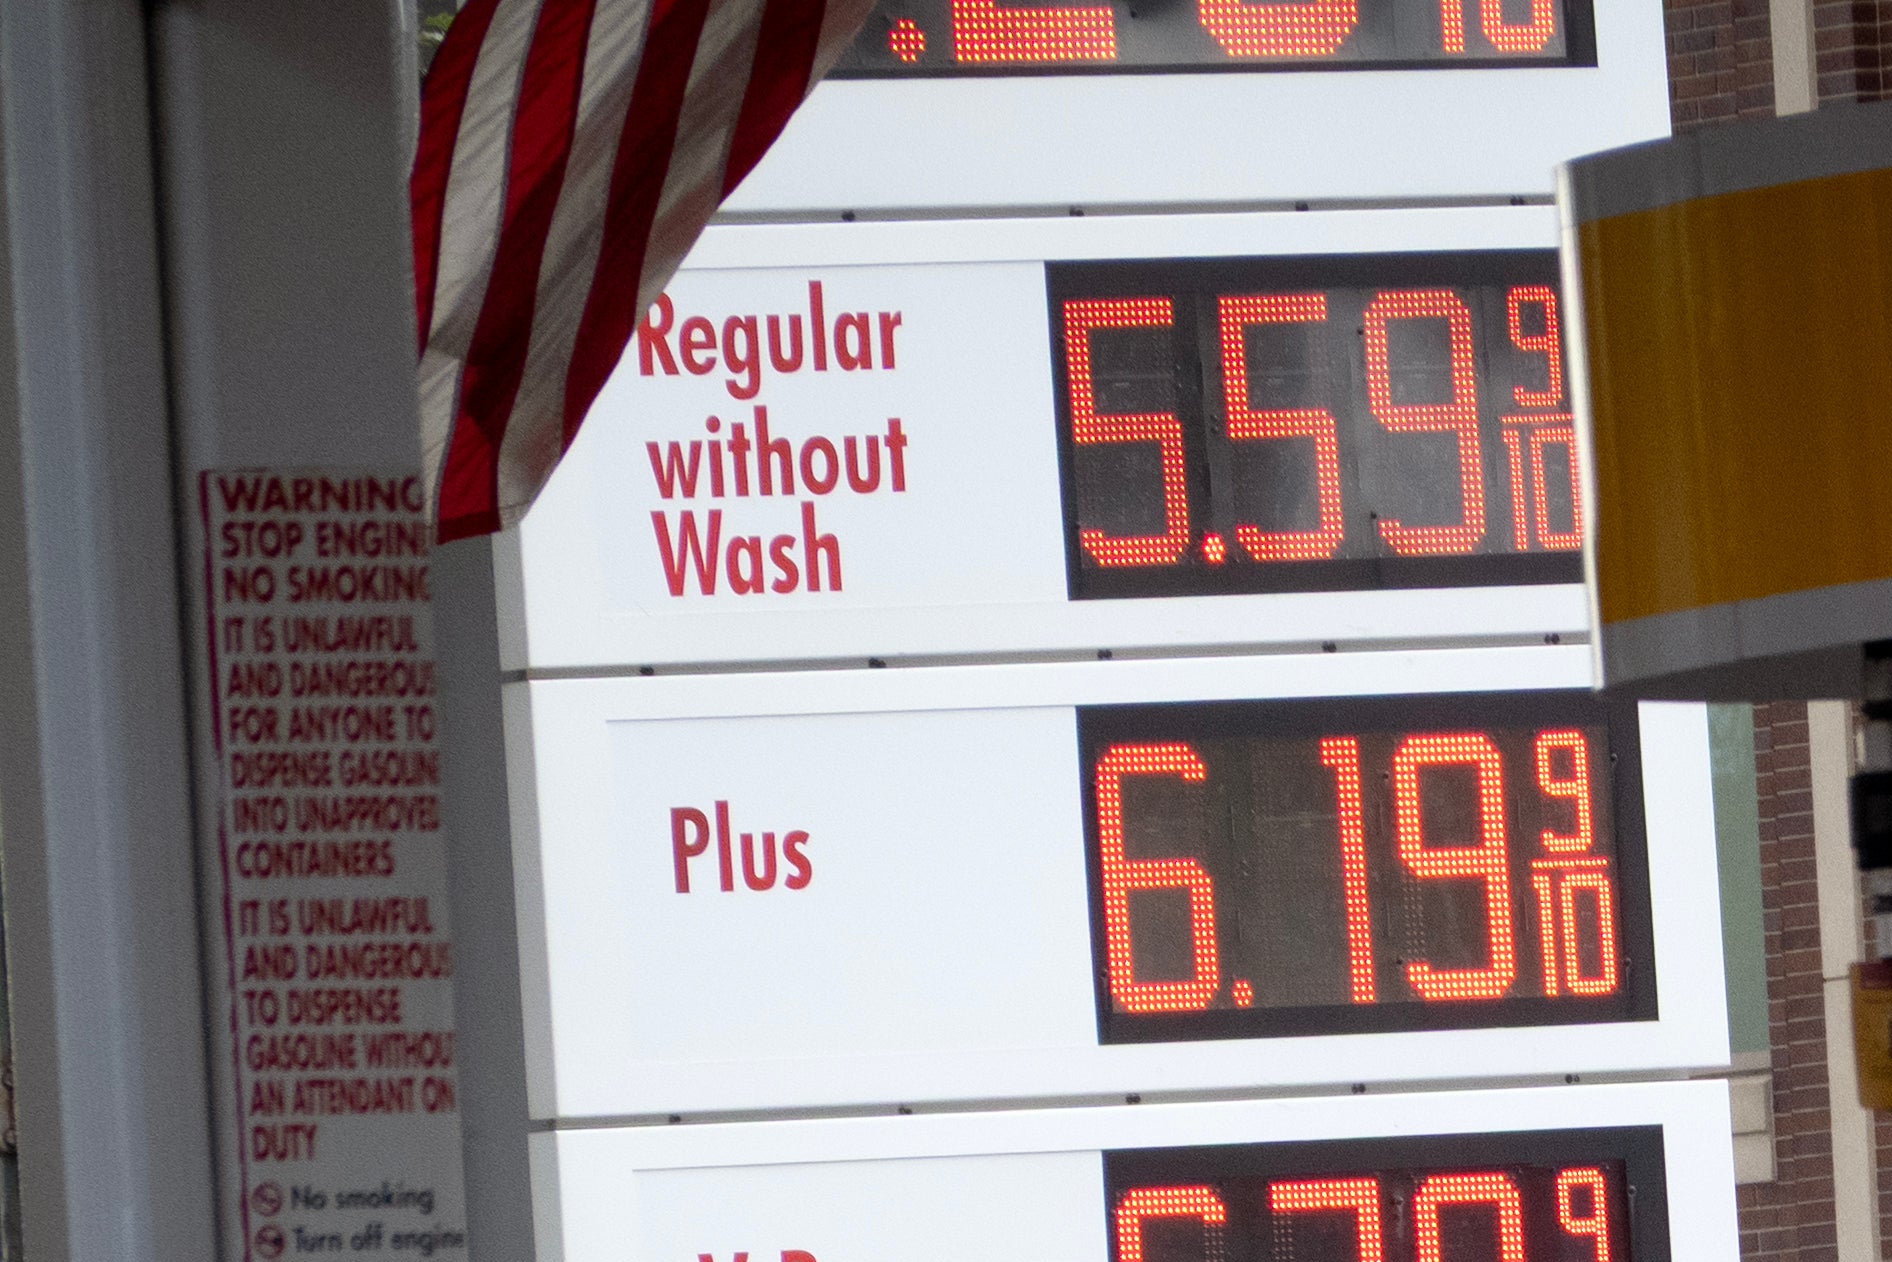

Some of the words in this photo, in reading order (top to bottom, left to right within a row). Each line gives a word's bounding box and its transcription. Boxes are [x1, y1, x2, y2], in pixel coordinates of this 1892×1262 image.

[636, 280, 901, 400] Regular
[1064, 290, 1486, 565] 5.59
[645, 405, 907, 499] without
[222, 520, 303, 558] STOP
[650, 500, 843, 596] Wash
[223, 565, 275, 603] NO
[224, 617, 244, 651] IT
[253, 616, 275, 652] IS
[283, 616, 418, 651] UNLAWFUL
[228, 660, 281, 697] AND
[230, 706, 278, 743] FOR
[288, 706, 395, 743] ANYONE
[405, 706, 434, 742] TO
[231, 751, 331, 789] DISPENSE
[339, 750, 438, 787] GASOLIN
[234, 796, 288, 833] INTO
[236, 841, 394, 879] CONTAINERS
[670, 800, 812, 893] Plus
[1097, 733, 1516, 1013] 6.19
[240, 900, 260, 936] IT
[269, 900, 290, 936] IS
[300, 897, 432, 935] UNLAWFUL
[243, 946, 297, 982] AND
[243, 989, 279, 1025] TO
[288, 988, 400, 1025] DISPENSE
[247, 1033, 355, 1071] GASOLINE
[364, 1032, 453, 1068] WITHOU
[250, 1078, 285, 1115] AN
[293, 1078, 415, 1115] ATTENDANT
[422, 1077, 455, 1112] ON
[253, 1124, 317, 1161] DUTY
[291, 1185, 327, 1209] No
[335, 1182, 434, 1214] smoking
[294, 1226, 343, 1252] Turn
[350, 1223, 382, 1250] off
[391, 1224, 464, 1256] engine
